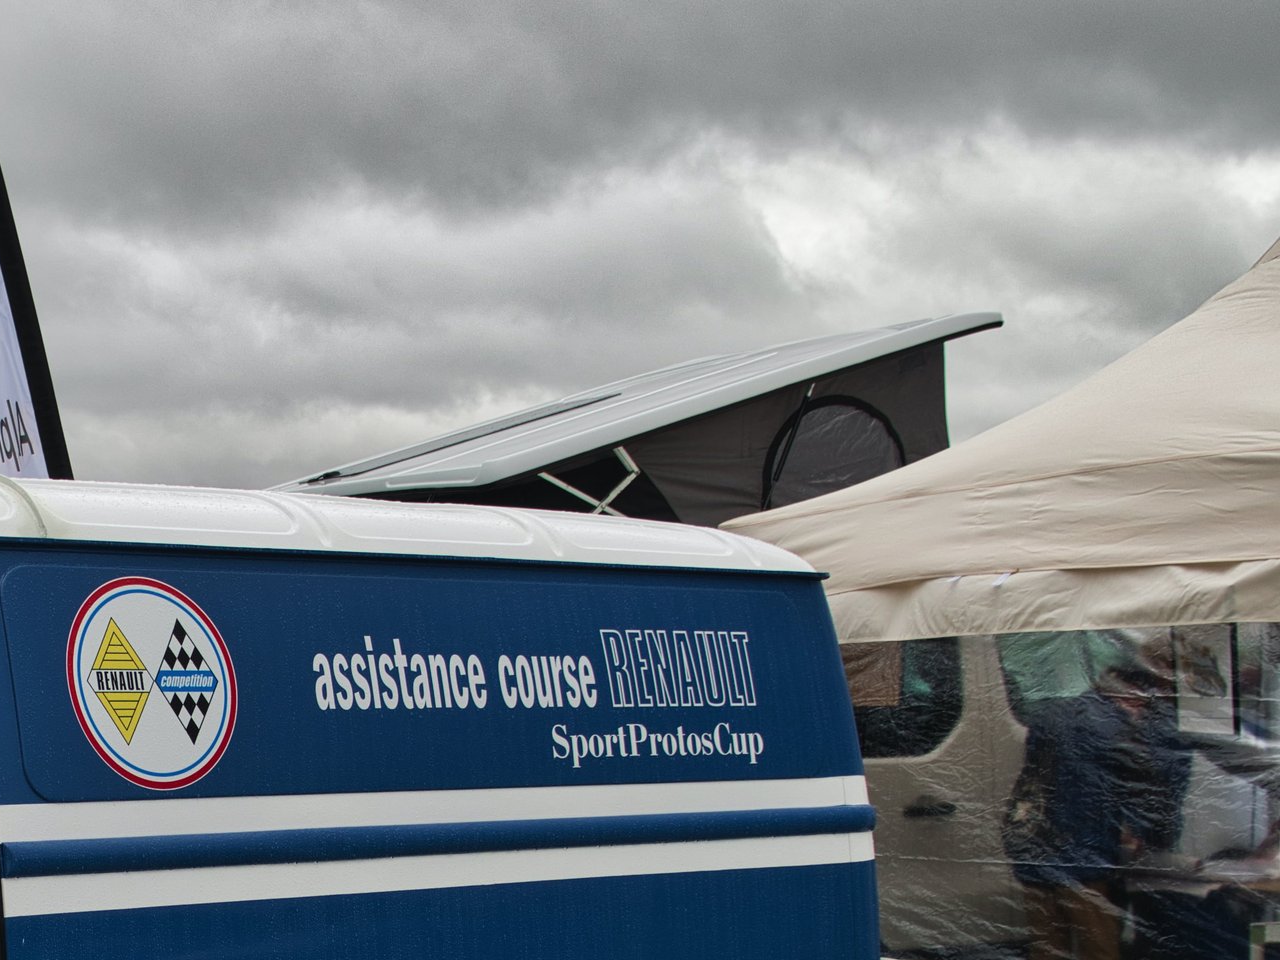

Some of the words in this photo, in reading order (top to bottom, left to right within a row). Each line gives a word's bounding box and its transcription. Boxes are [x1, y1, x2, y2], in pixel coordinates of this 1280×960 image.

[95, 670, 146, 692] RENAULT
[160, 673, 214, 689] competition
[312, 634, 488, 711] assistance
[497, 653, 598, 709] course
[599, 628, 757, 708] RENAULT
[551, 722, 765, 769] SportProtosCup
